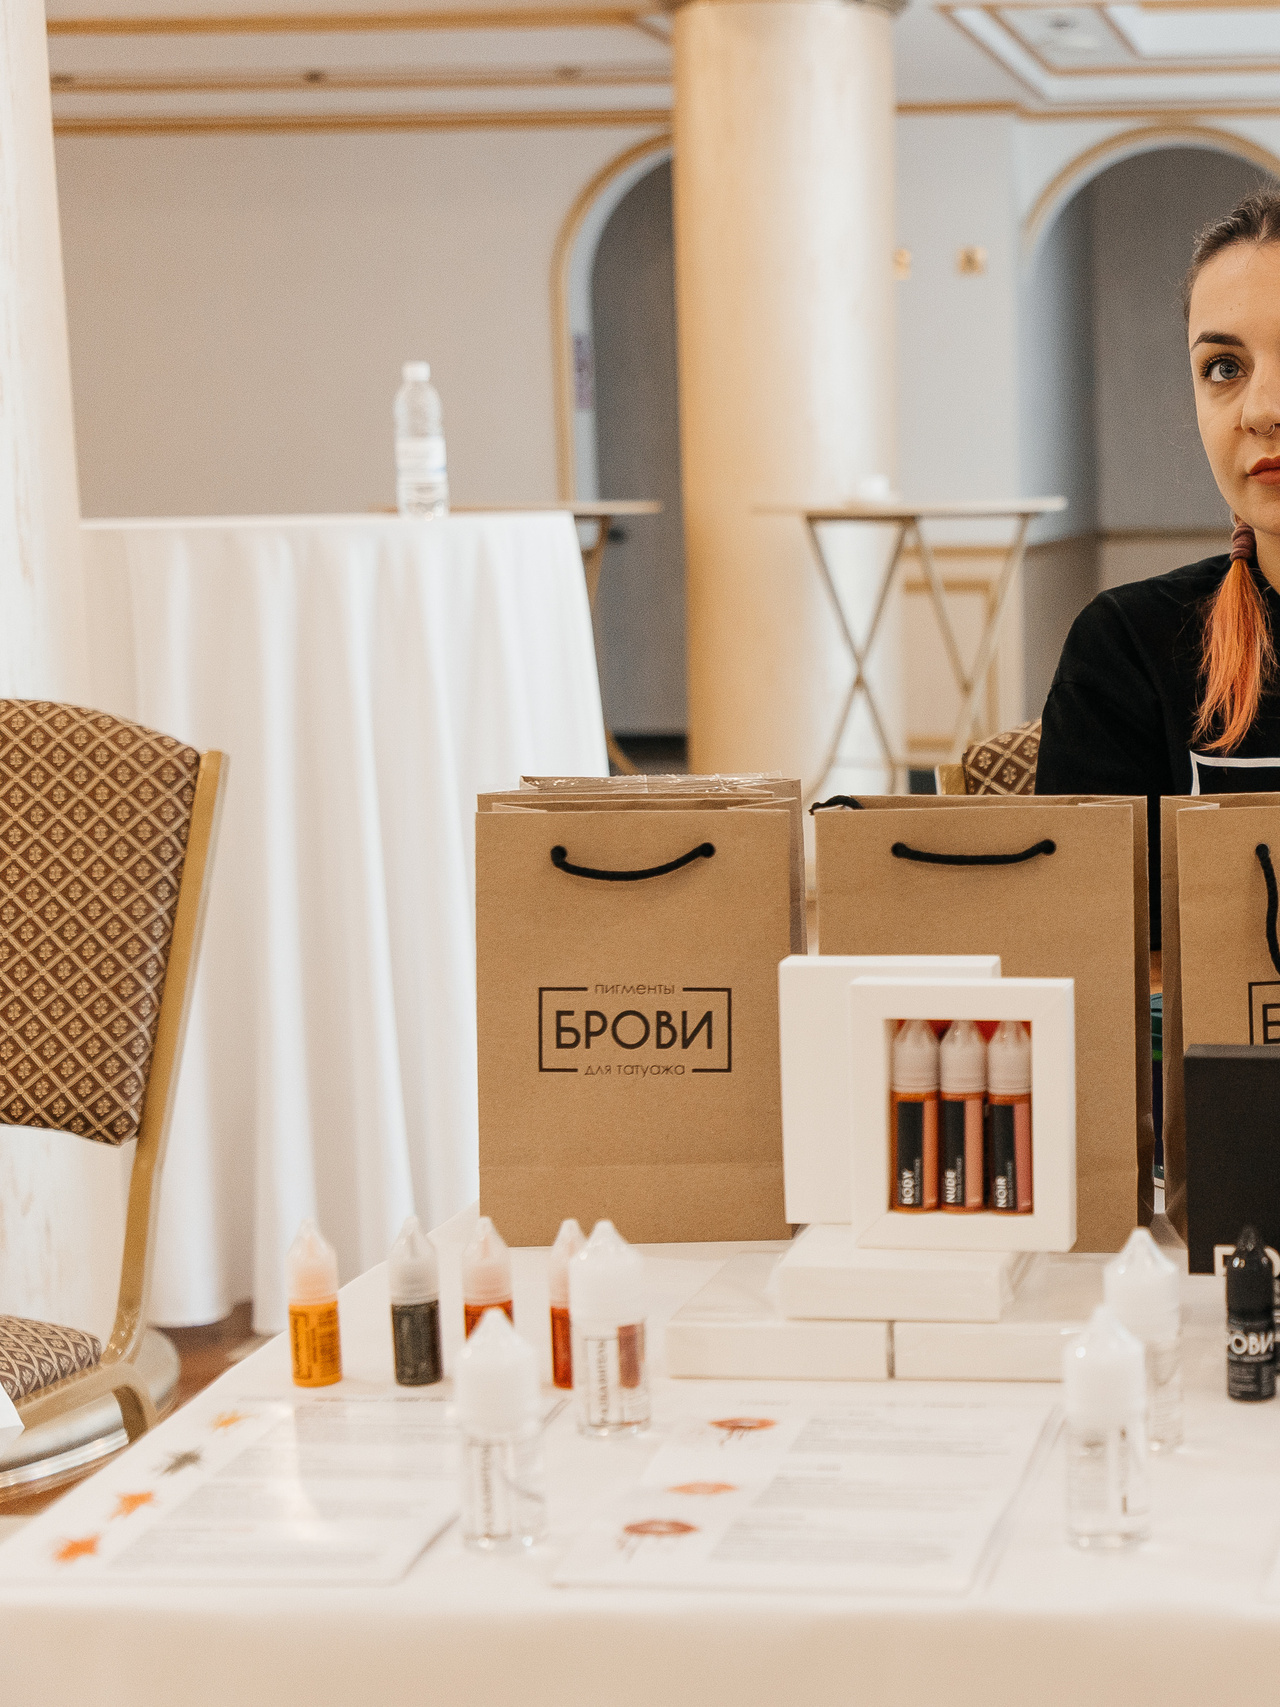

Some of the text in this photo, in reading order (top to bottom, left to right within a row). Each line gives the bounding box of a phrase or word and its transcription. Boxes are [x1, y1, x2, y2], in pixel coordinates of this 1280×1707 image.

[594, 983, 676, 995] пигменты
[555, 1009, 713, 1050] БРОВИ
[584, 1064, 686, 1078] для татуажа
[901, 1167, 915, 1205] BODY
[945, 1168, 956, 1203] NUDE
[995, 1175, 1008, 1208] NOIR
